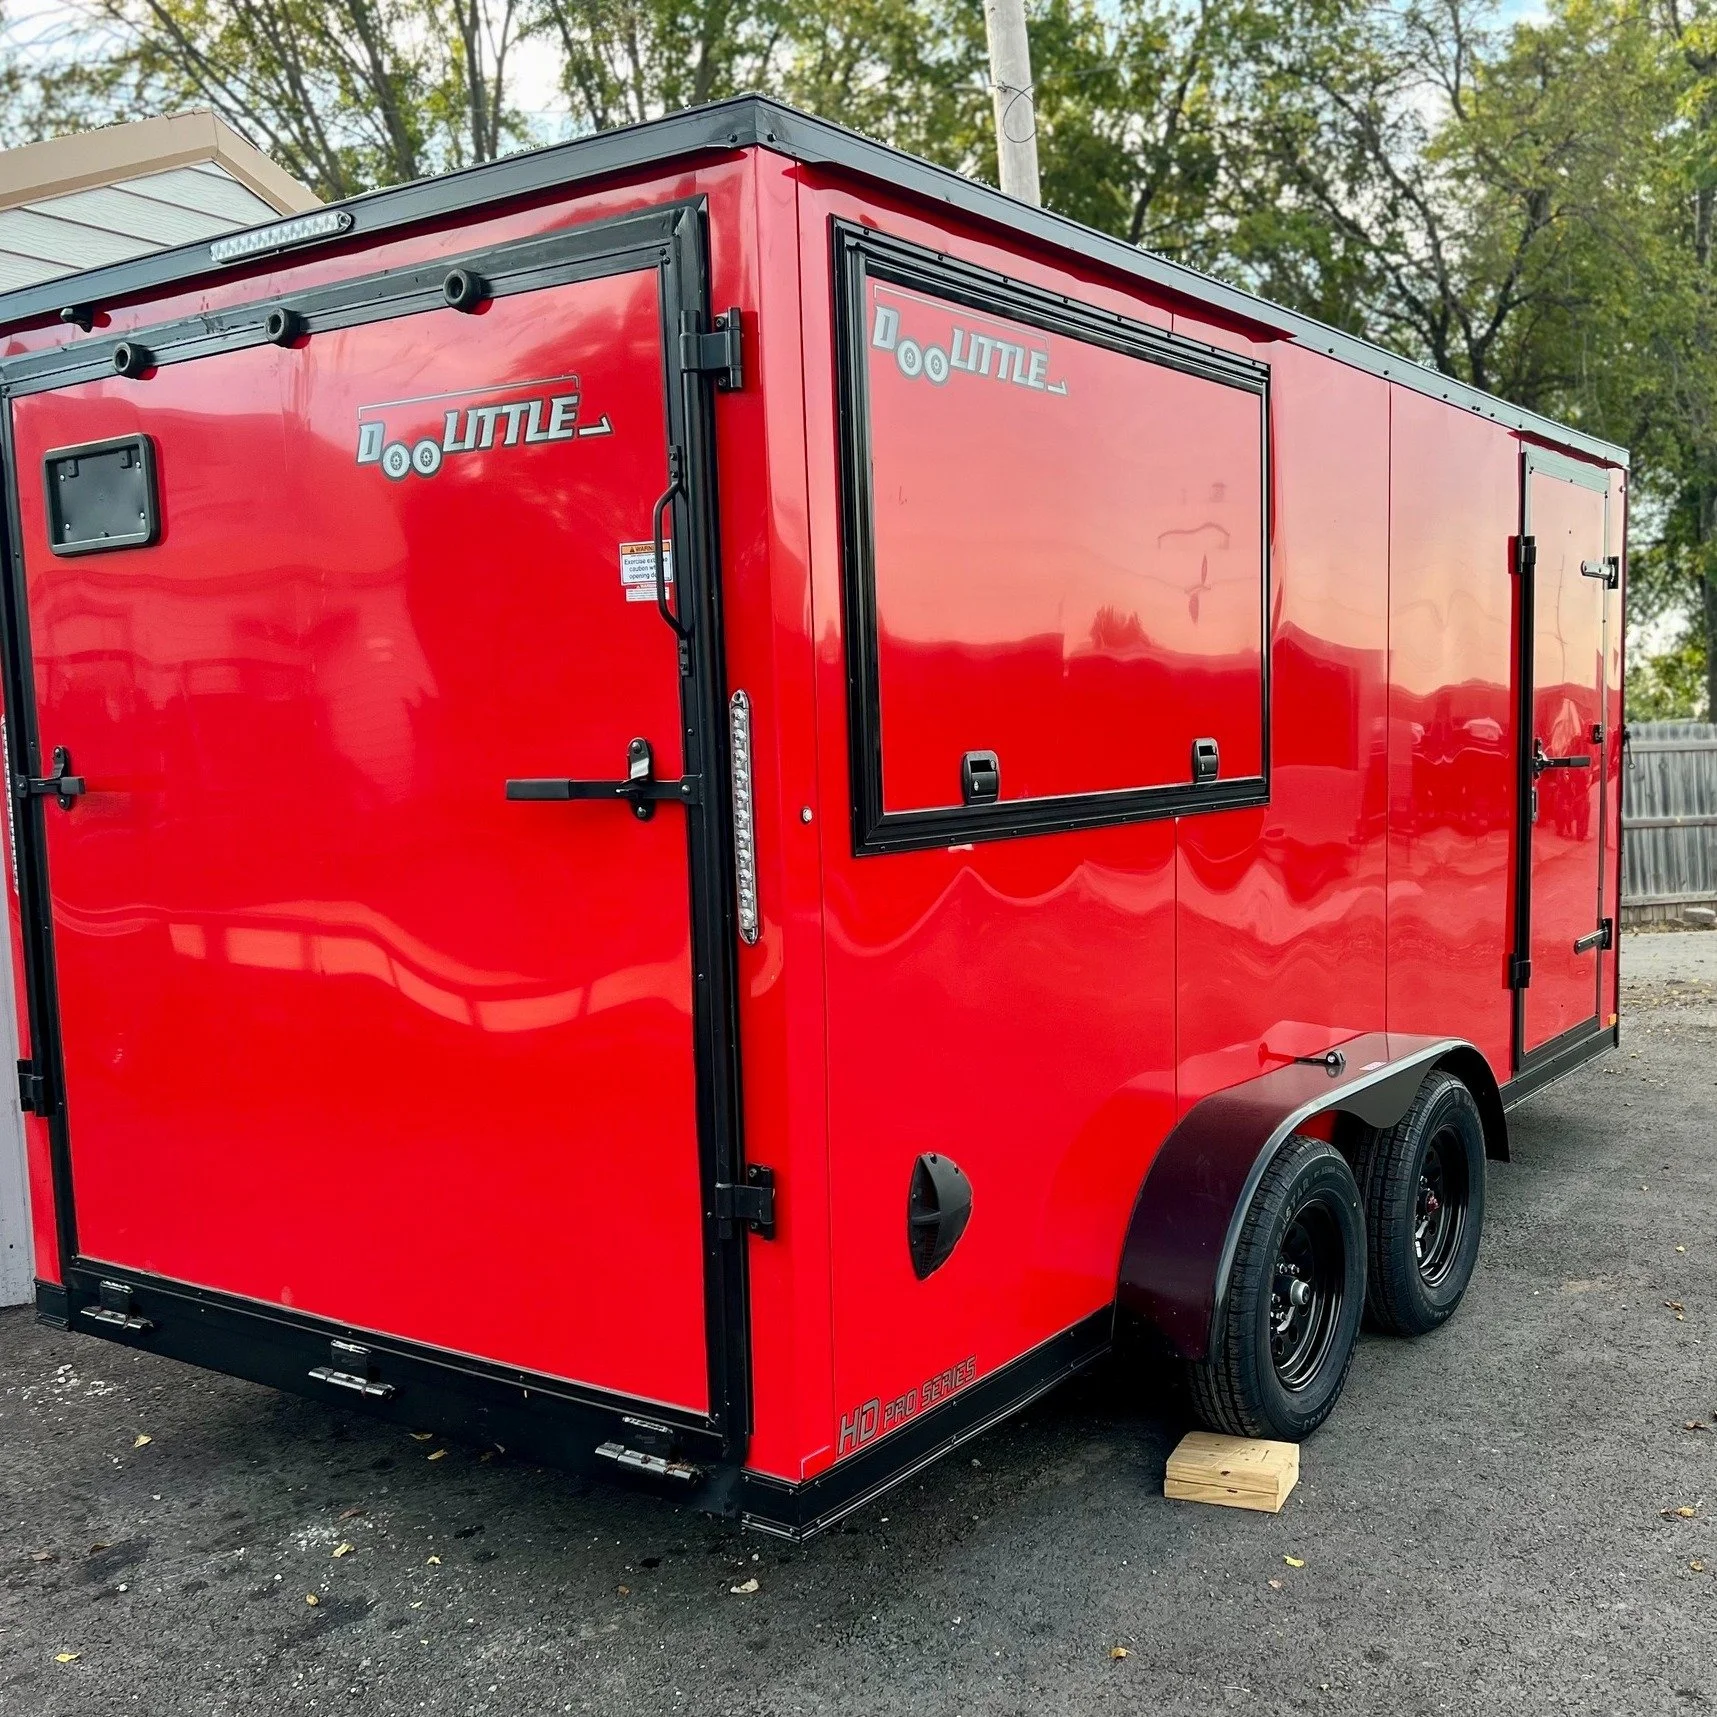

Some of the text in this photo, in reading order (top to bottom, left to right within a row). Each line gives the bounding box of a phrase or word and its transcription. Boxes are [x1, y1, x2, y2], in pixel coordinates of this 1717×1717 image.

[624, 557, 647, 566] Exercise
[838, 1354, 977, 1456] HD PRO SERIES
